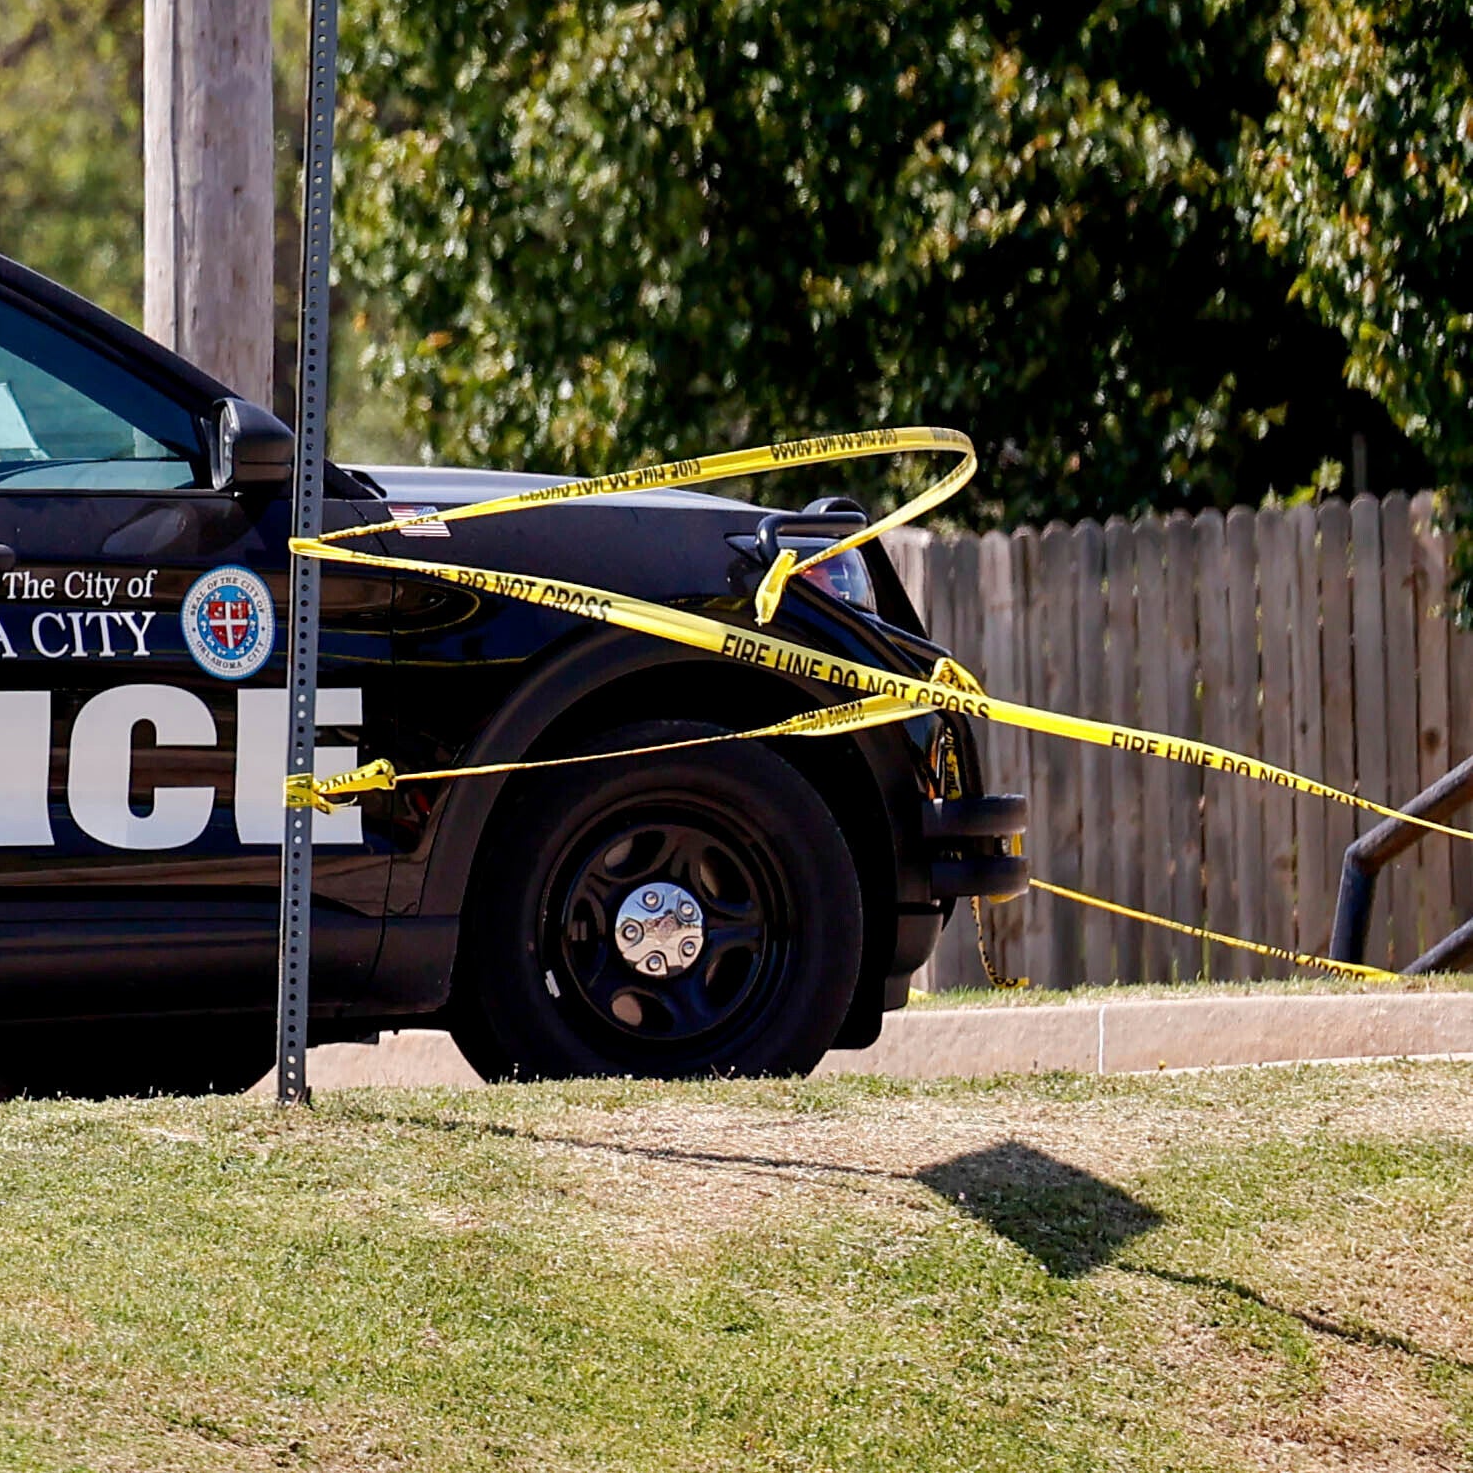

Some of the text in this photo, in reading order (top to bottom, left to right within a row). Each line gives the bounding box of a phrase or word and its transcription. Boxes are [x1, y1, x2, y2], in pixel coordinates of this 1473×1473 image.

[2, 569, 158, 606] The City of
[220, 576, 239, 584] THE
[241, 579, 260, 598] CITY
[31, 611, 157, 659] CITY
[721, 632, 770, 665] FIRE
[196, 640, 265, 669] OKLAHOMA CITY
